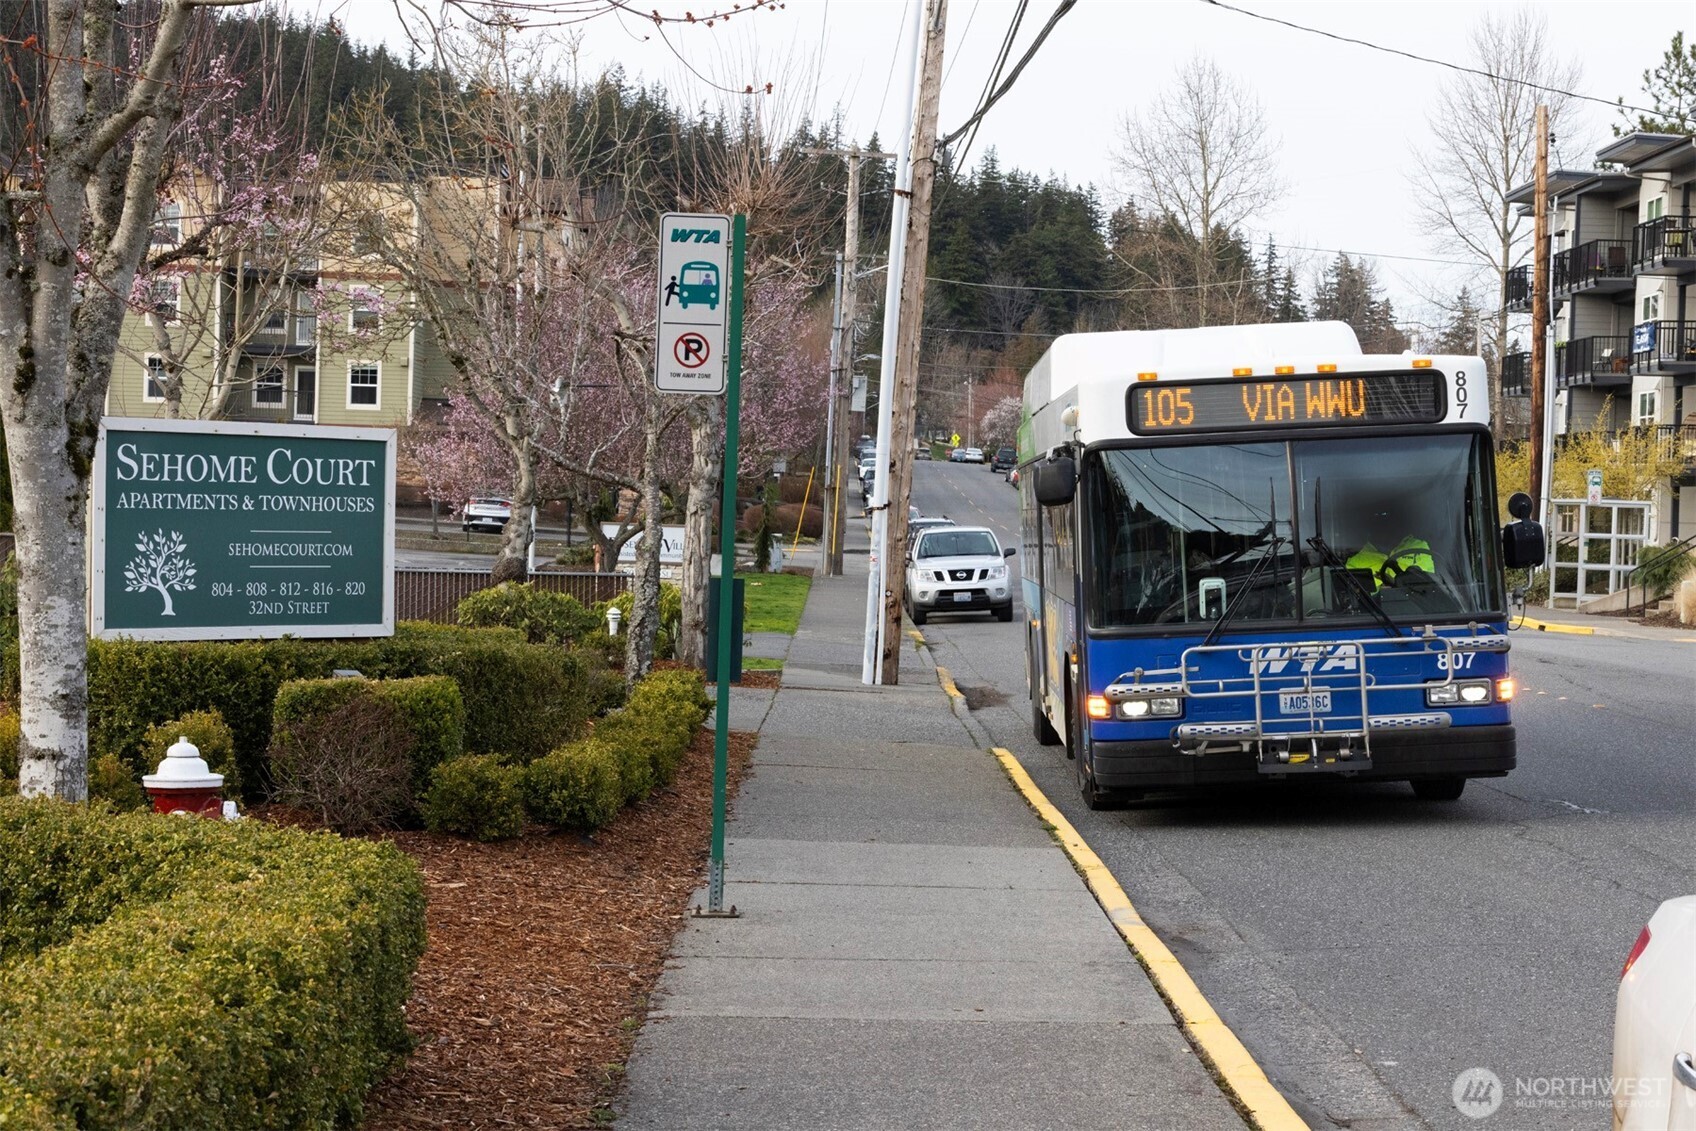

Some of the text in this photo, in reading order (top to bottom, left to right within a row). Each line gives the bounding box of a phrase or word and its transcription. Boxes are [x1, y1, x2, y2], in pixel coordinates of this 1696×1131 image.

[671, 228, 721, 244] WTA
[1144, 379, 1366, 427] 105 VIA WWU
[1454, 370, 1469, 420] 807
[116, 443, 376, 487] SEHOME COURT
[116, 492, 376, 513] APARTMENTS & TOWNHOUSES
[228, 543, 353, 557] SEHOMECOURT.COM
[211, 582, 234, 597] 804
[246, 582, 267, 596] 808
[279, 582, 300, 596] 812
[312, 582, 333, 596] 816
[345, 581, 365, 595] 820
[249, 600, 330, 615] 32ND STREET
[1249, 643, 1357, 675] WTA
[1436, 650, 1476, 670] 807
